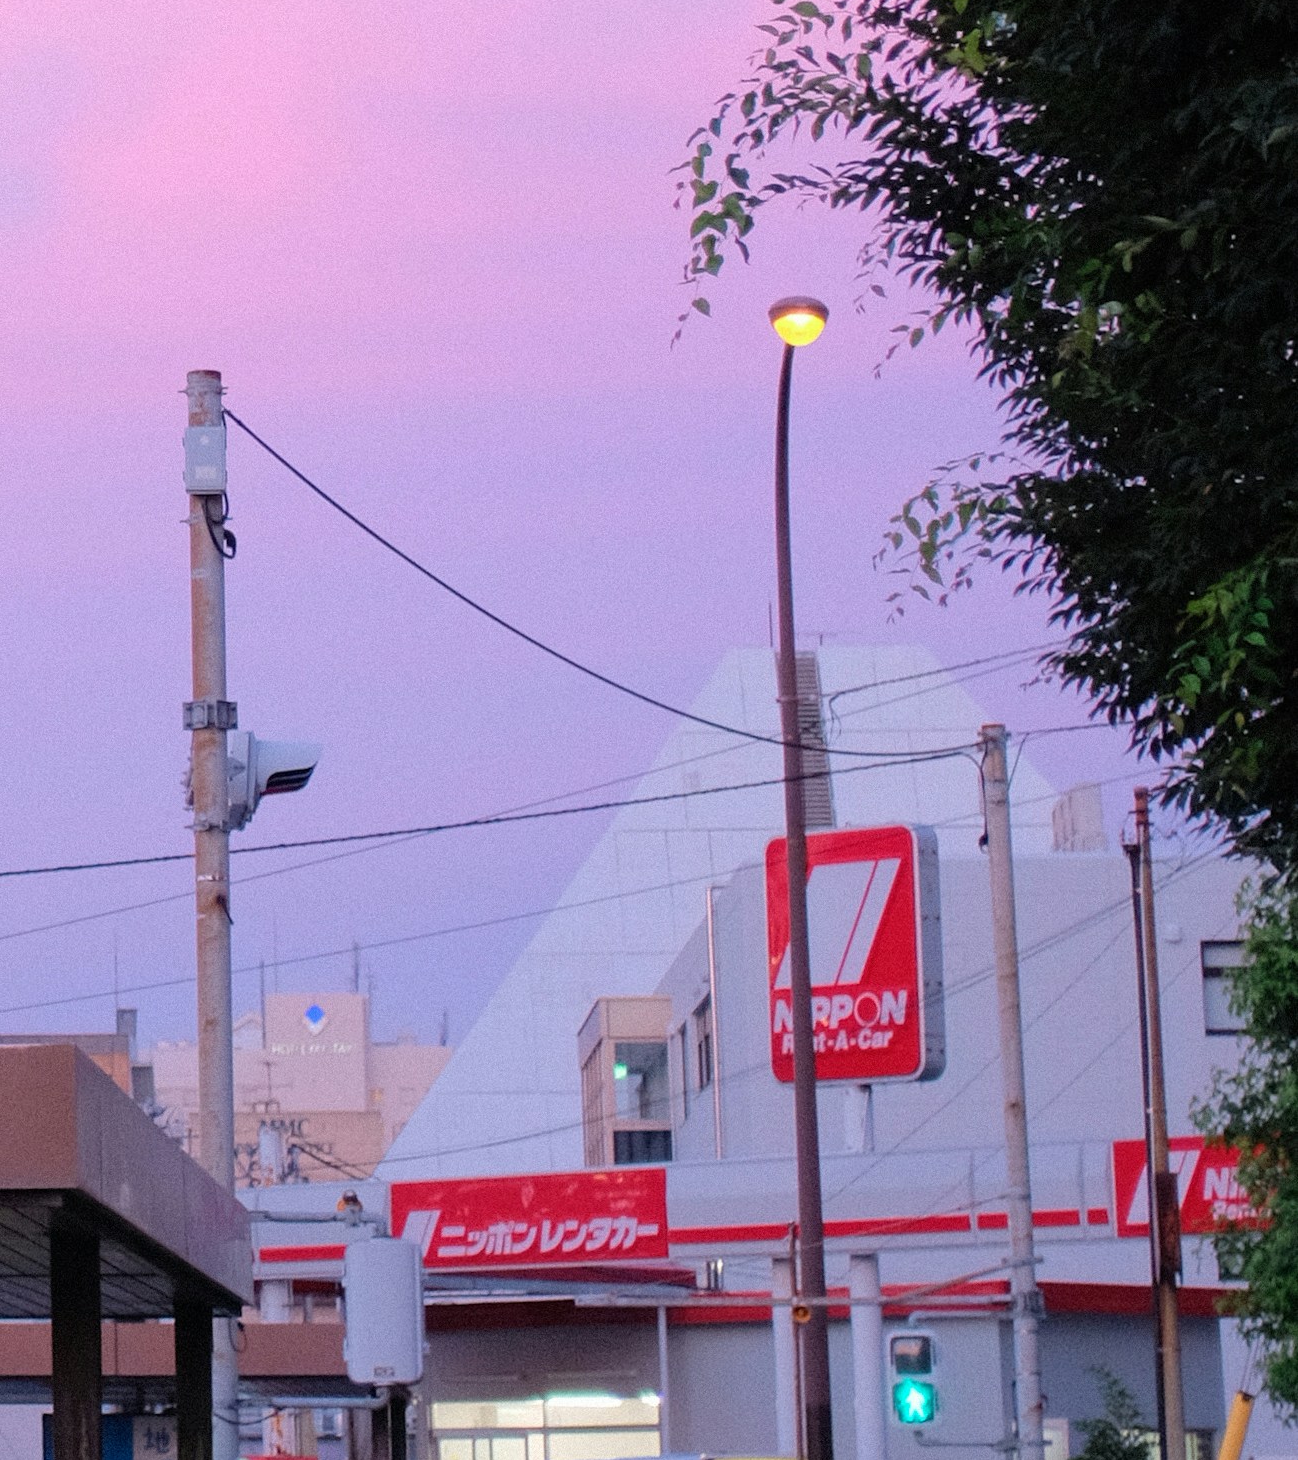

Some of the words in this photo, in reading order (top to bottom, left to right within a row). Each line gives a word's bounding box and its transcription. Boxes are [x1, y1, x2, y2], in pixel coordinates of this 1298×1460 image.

[774, 990, 908, 1033] NPPON
[437, 1215, 660, 1258] ニッポンレンタカー
